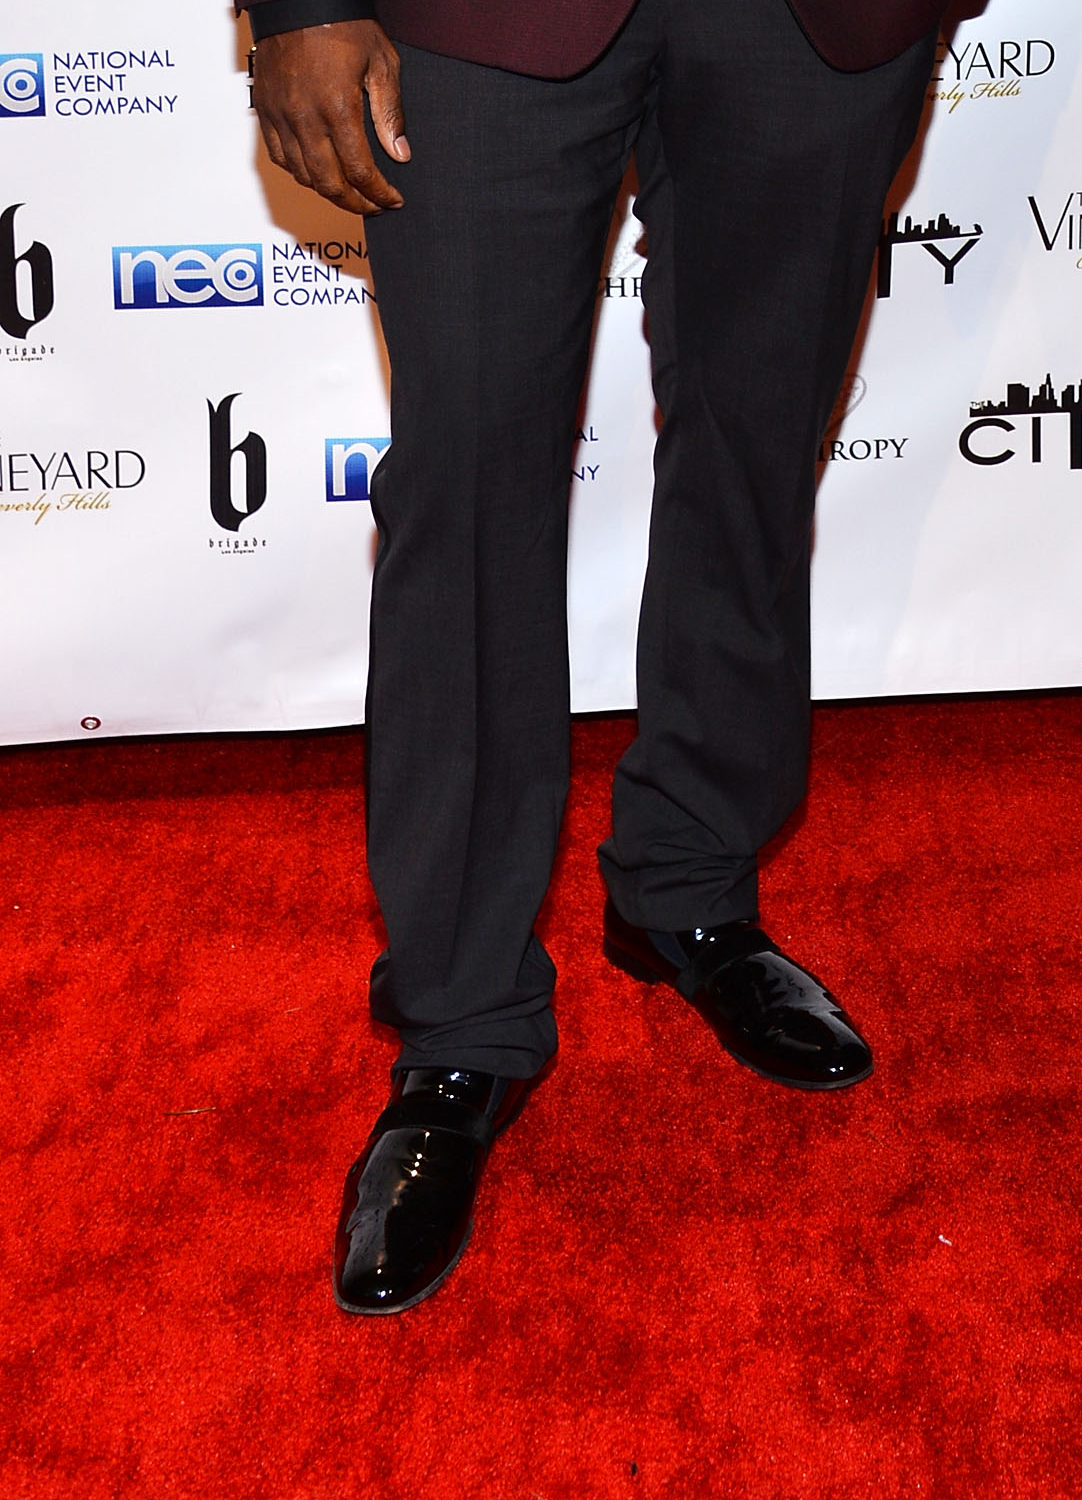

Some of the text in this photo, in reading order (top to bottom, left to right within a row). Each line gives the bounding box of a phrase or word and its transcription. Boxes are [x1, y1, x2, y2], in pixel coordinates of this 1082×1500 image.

[53, 50, 175, 71] NATIONAL
[54, 74, 126, 94] EVENT
[970, 79, 1021, 100] Hills
[55, 96, 178, 116] COMPANY
[273, 265, 343, 283] EVENT
[876, 235, 980, 299] TY
[273, 287, 376, 306] COMPAN
[56, 491, 111, 512] Hills
